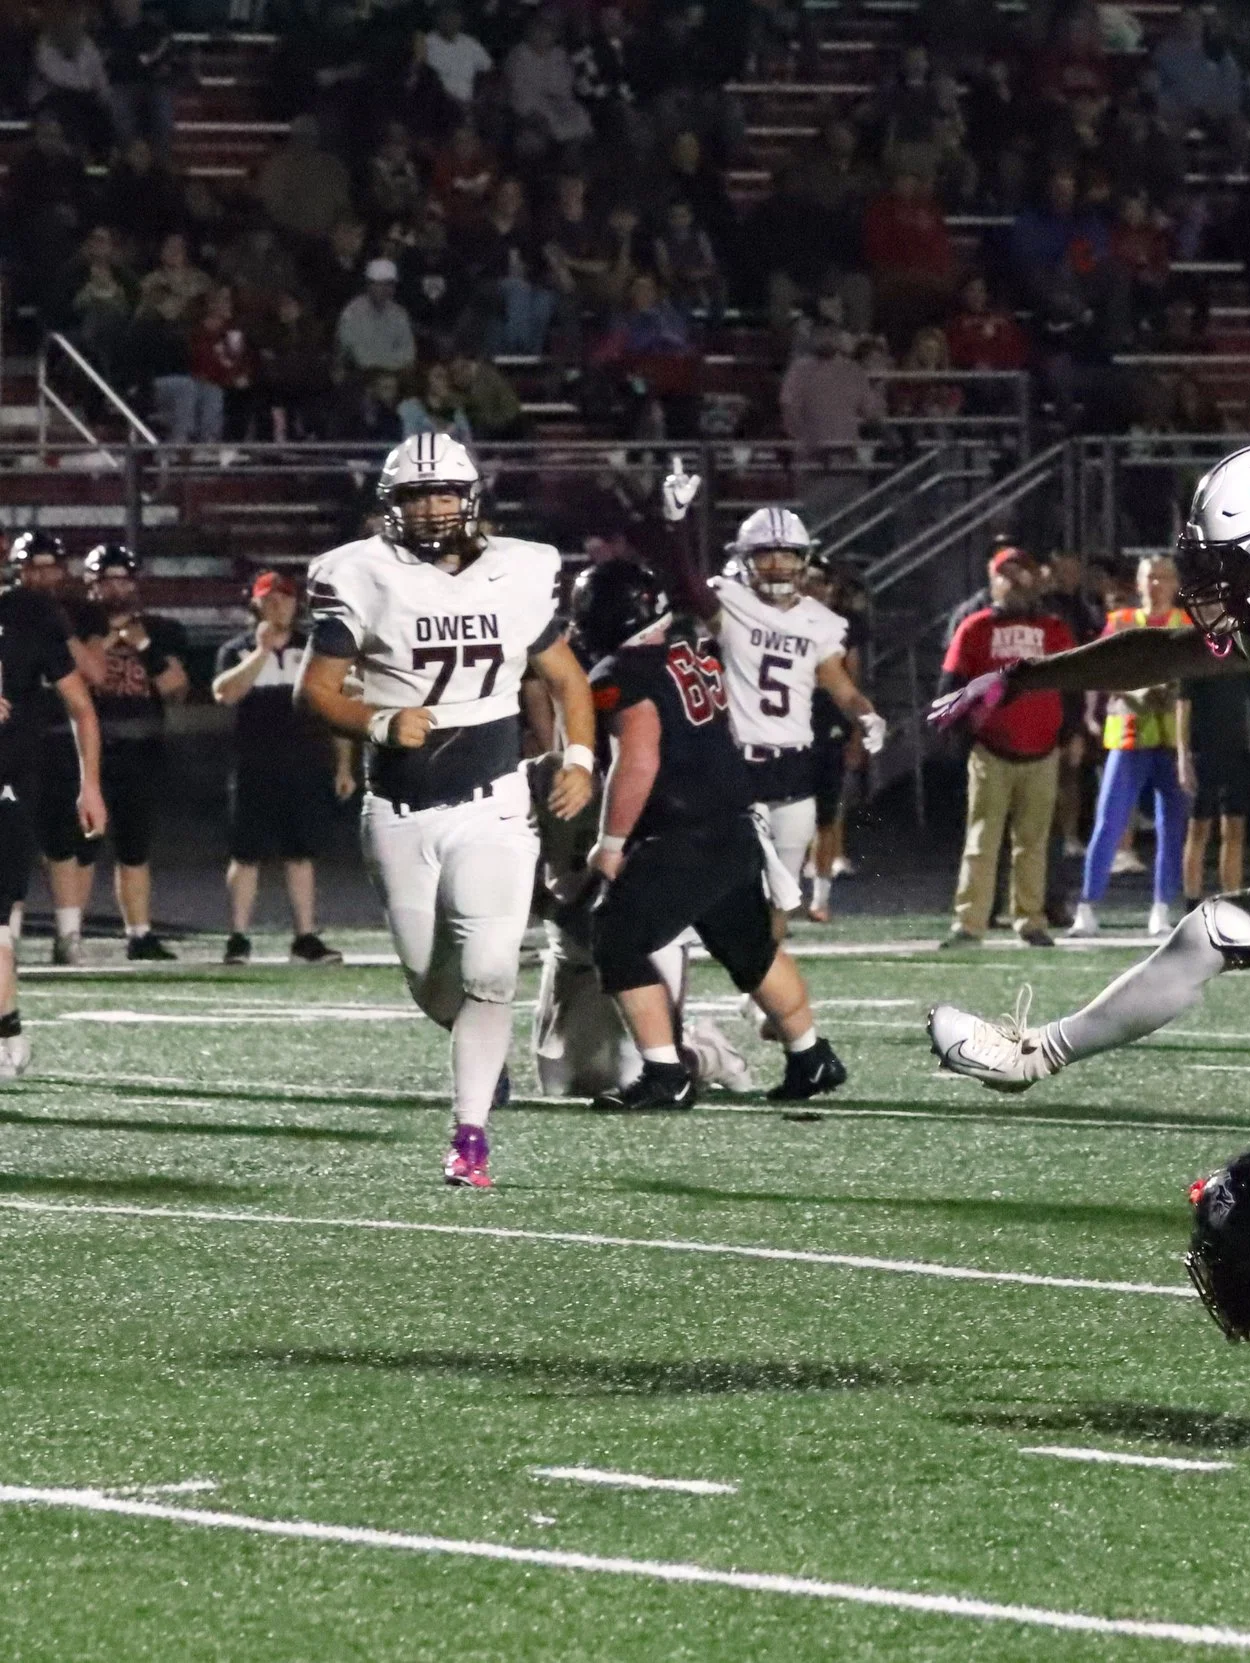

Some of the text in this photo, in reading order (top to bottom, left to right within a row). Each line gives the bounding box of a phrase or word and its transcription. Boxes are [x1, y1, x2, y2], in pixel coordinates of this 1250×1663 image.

[416, 614, 499, 641] OWEN
[750, 628, 810, 657] OWEN
[412, 644, 505, 707] 77
[759, 653, 793, 717] 5
